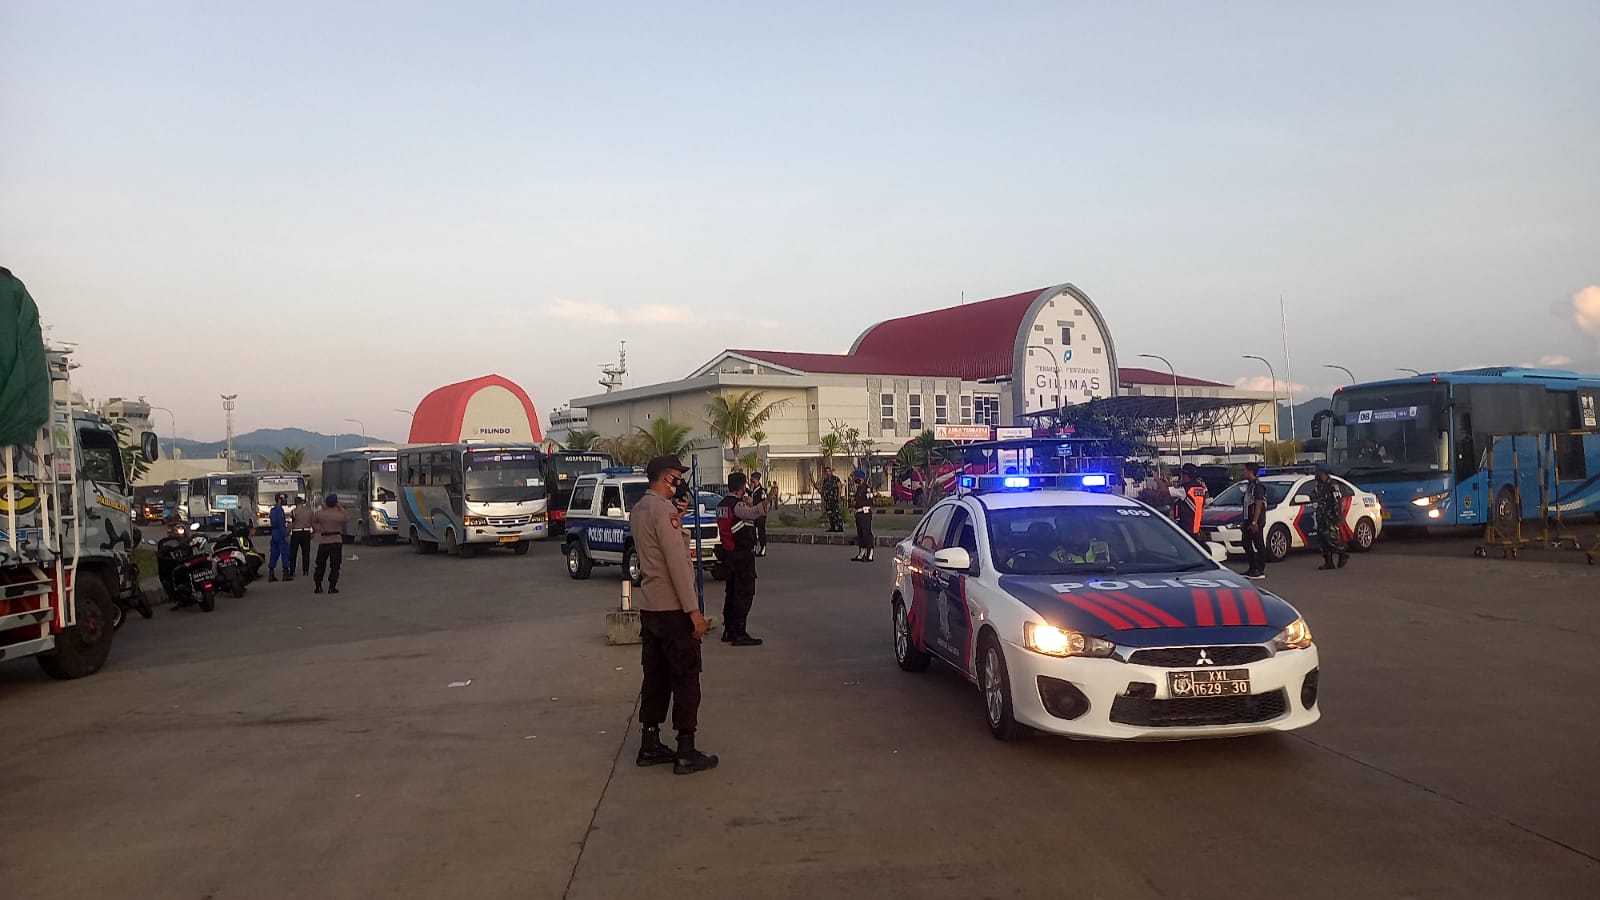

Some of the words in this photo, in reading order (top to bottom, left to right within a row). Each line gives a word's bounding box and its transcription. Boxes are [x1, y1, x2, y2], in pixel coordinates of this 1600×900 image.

[1036, 374, 1100, 390] GILIMAS
[1050, 579, 1241, 594] POLISI
[1195, 683, 1222, 695] 1629
[1231, 682, 1247, 694] 30
